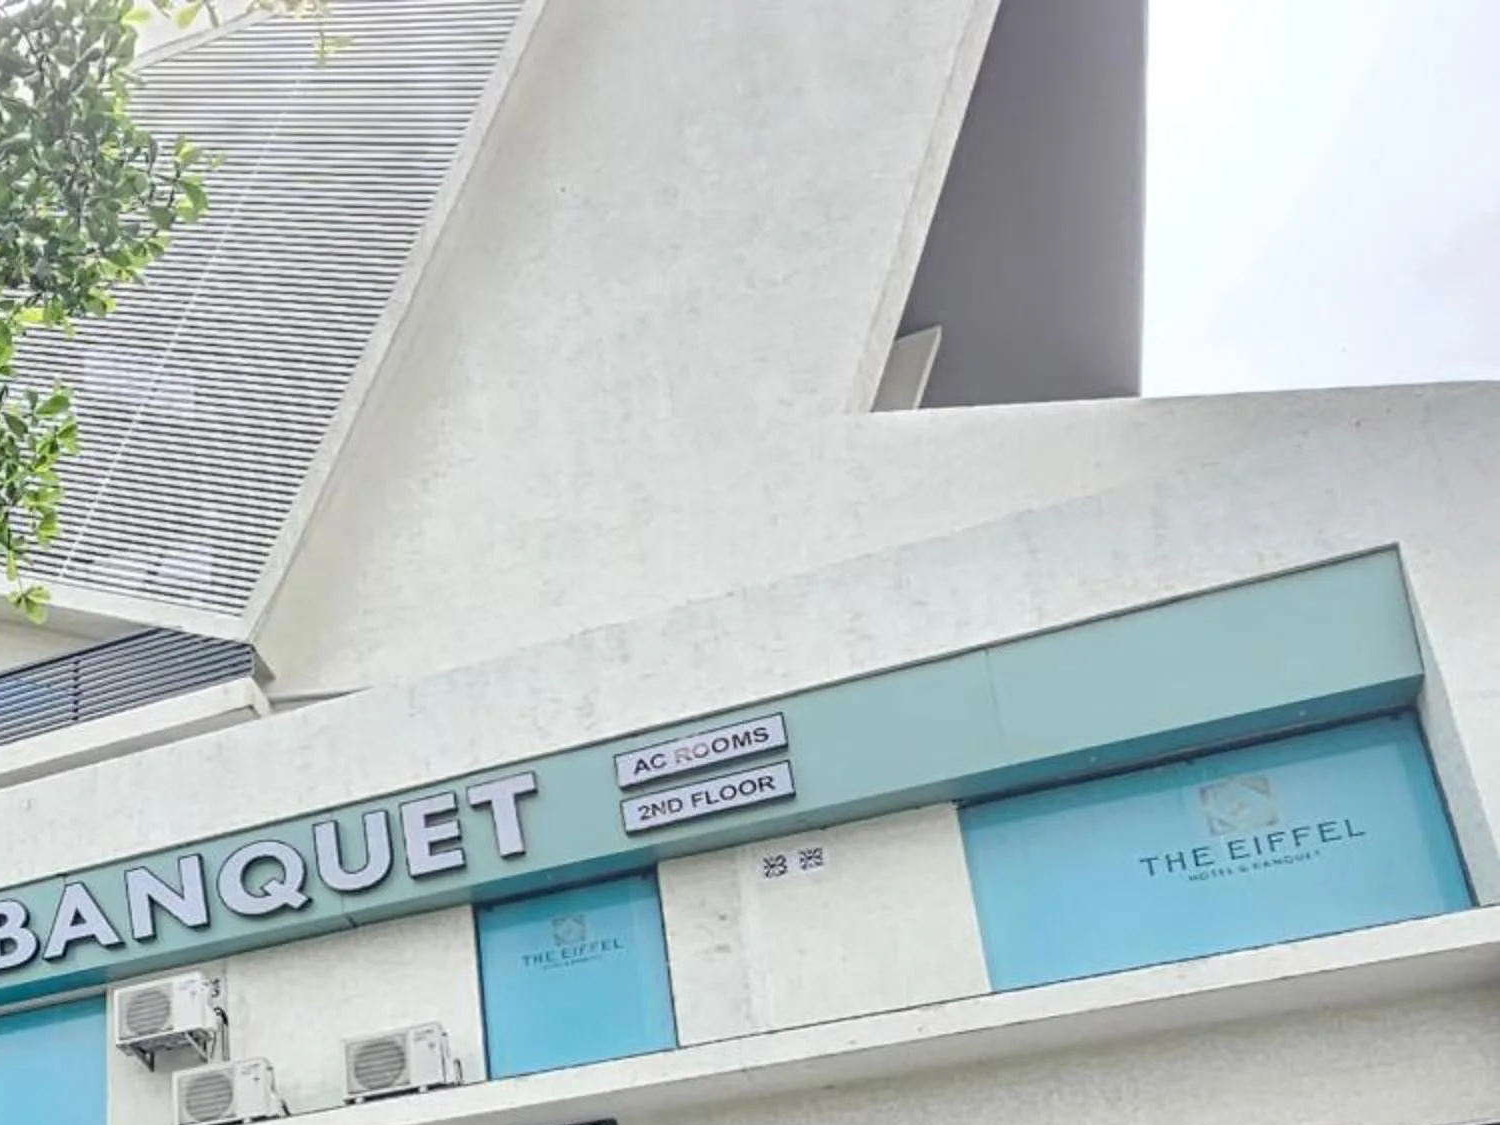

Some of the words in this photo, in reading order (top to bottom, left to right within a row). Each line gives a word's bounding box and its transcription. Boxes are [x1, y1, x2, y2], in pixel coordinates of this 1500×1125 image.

[634, 753, 668, 775] AC
[674, 727, 770, 765] ROOMS
[637, 798, 684, 821] 2ND
[691, 775, 777, 809] FLOOR
[1139, 845, 1215, 877] THE
[1227, 818, 1367, 861] EIFFEL
